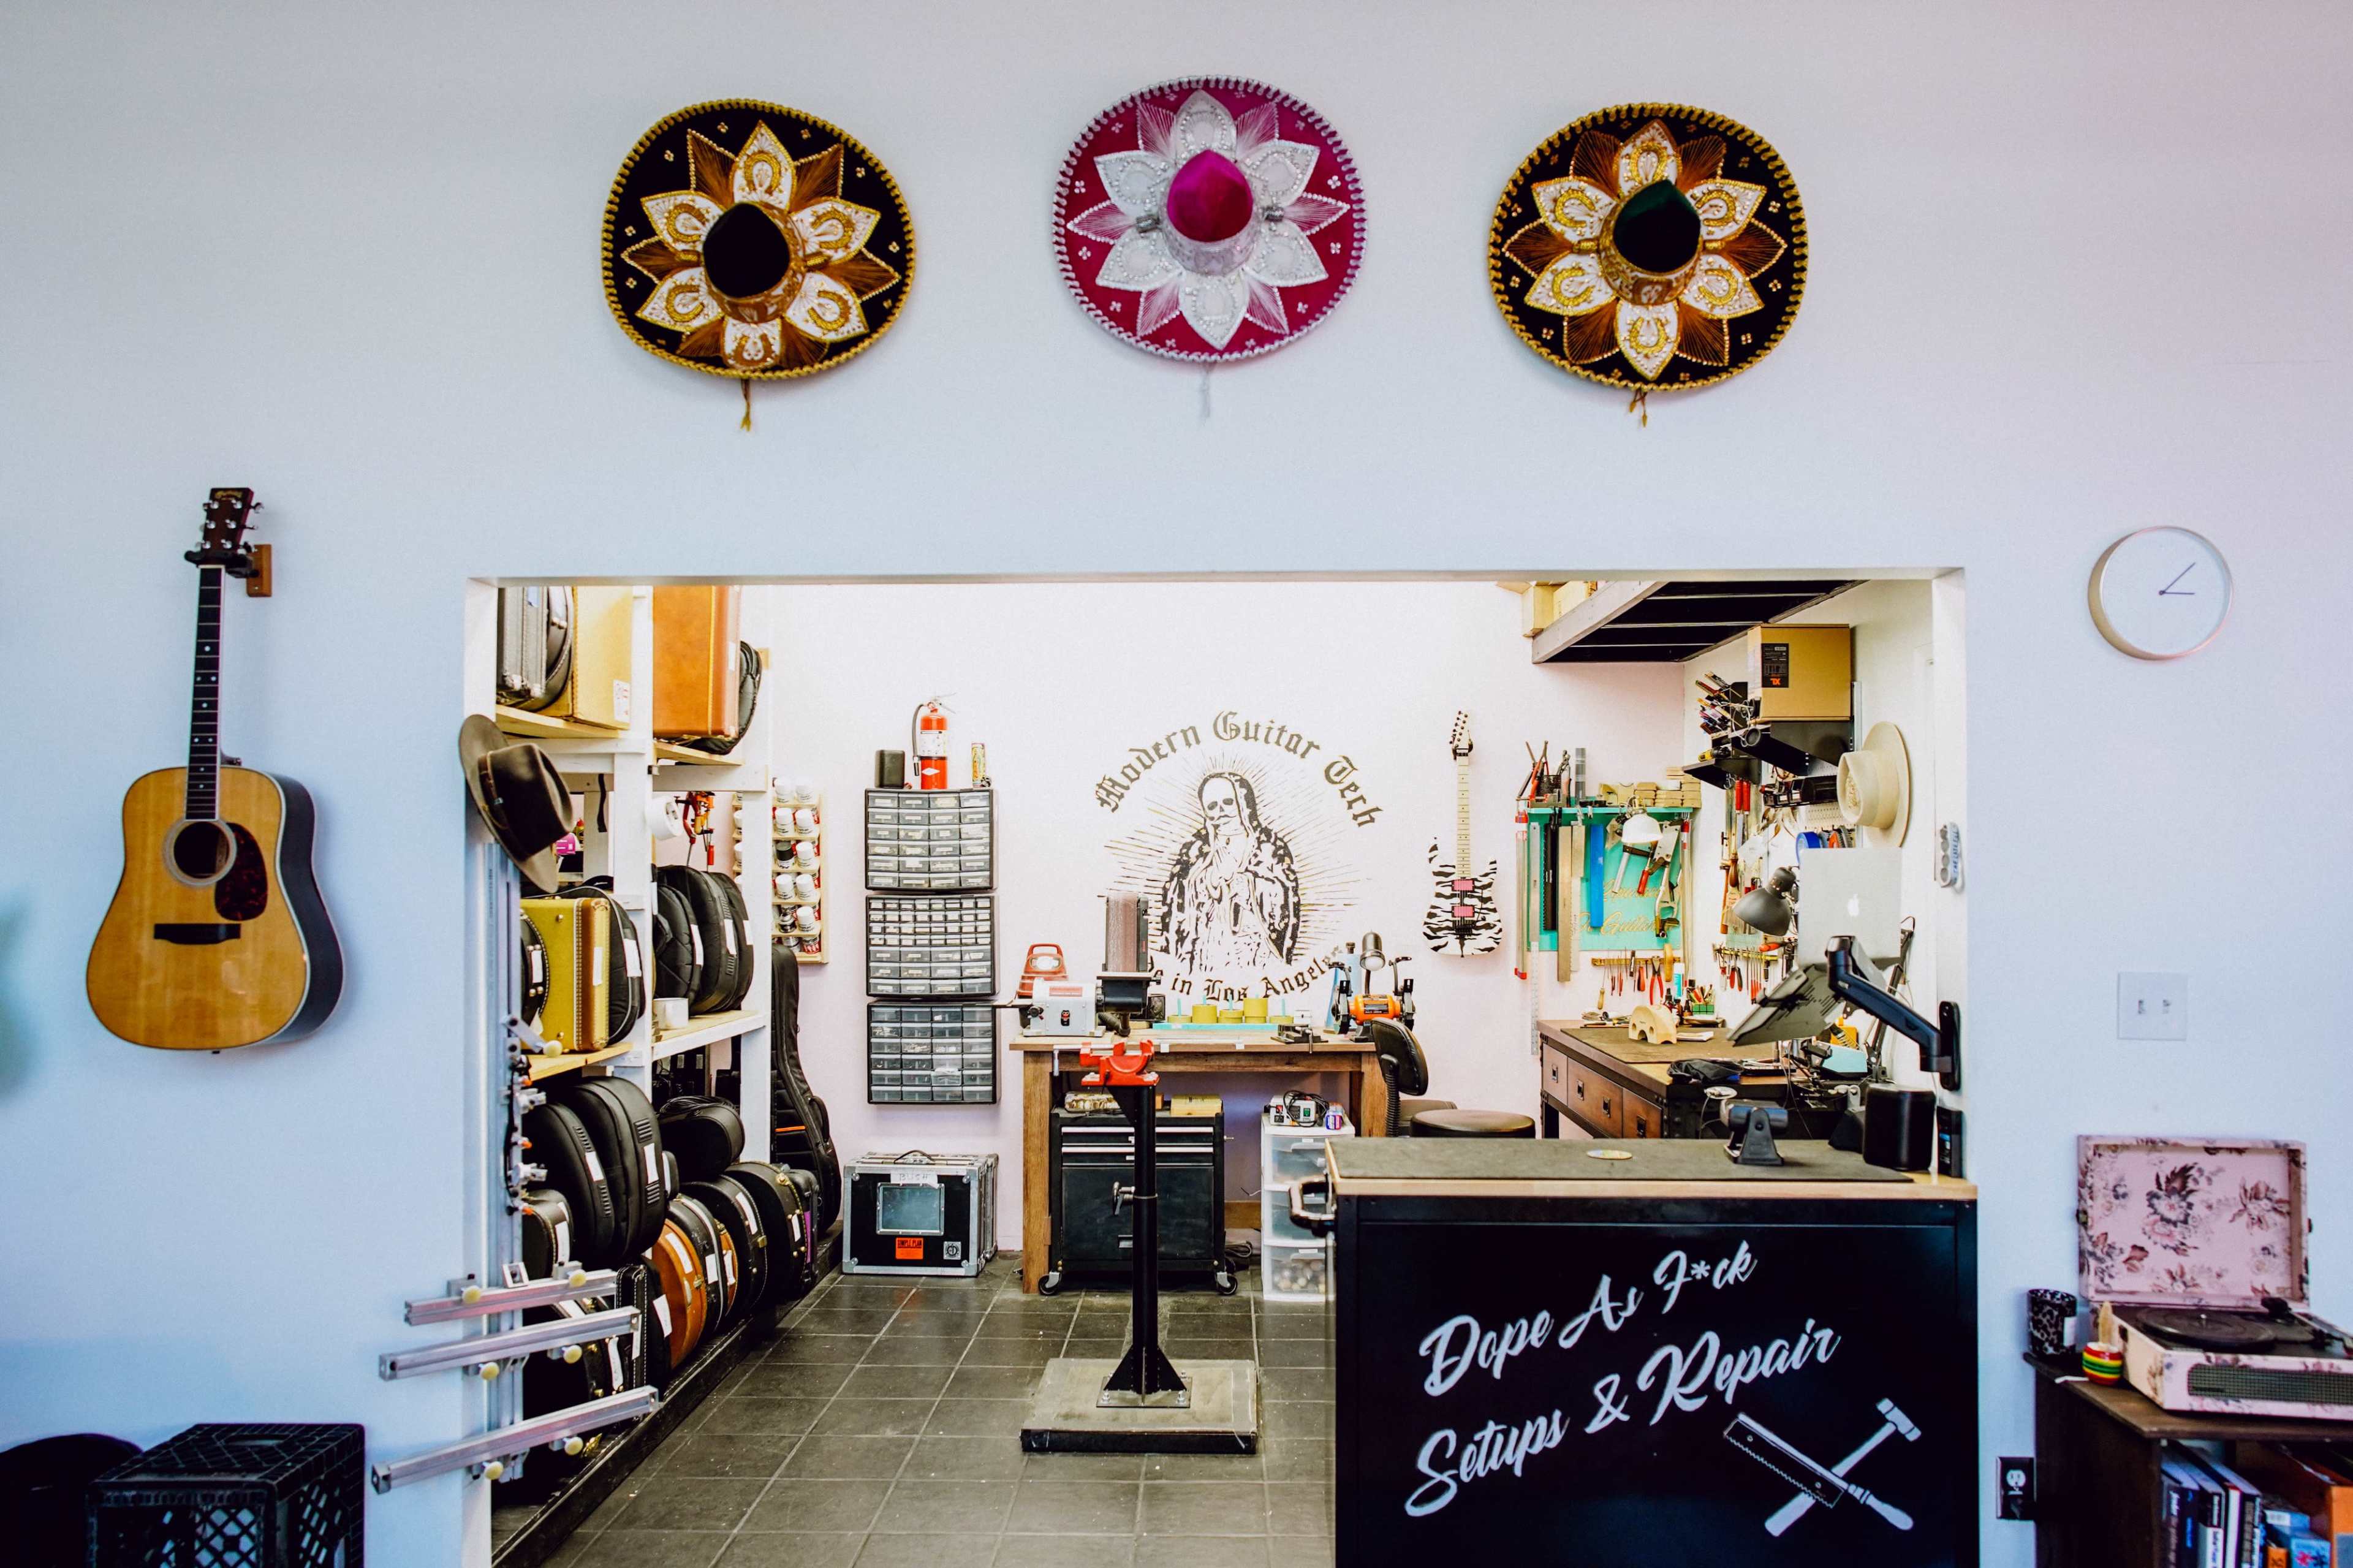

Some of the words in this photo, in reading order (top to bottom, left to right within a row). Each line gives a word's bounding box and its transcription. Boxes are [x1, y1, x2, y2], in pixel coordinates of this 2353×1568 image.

[1096, 725, 1201, 813] Modern
[1213, 710, 1320, 759] Guitar
[1324, 754, 1383, 827] Tech
[1170, 973, 1192, 995] in
[1203, 979, 1249, 1002] Los
[1419, 1310, 1554, 1396] Dope
[1558, 1274, 1643, 1349] As
[1405, 1409, 1569, 1517] Setups
[1585, 1374, 1630, 1433] &
[1637, 1319, 1841, 1426] Repair
